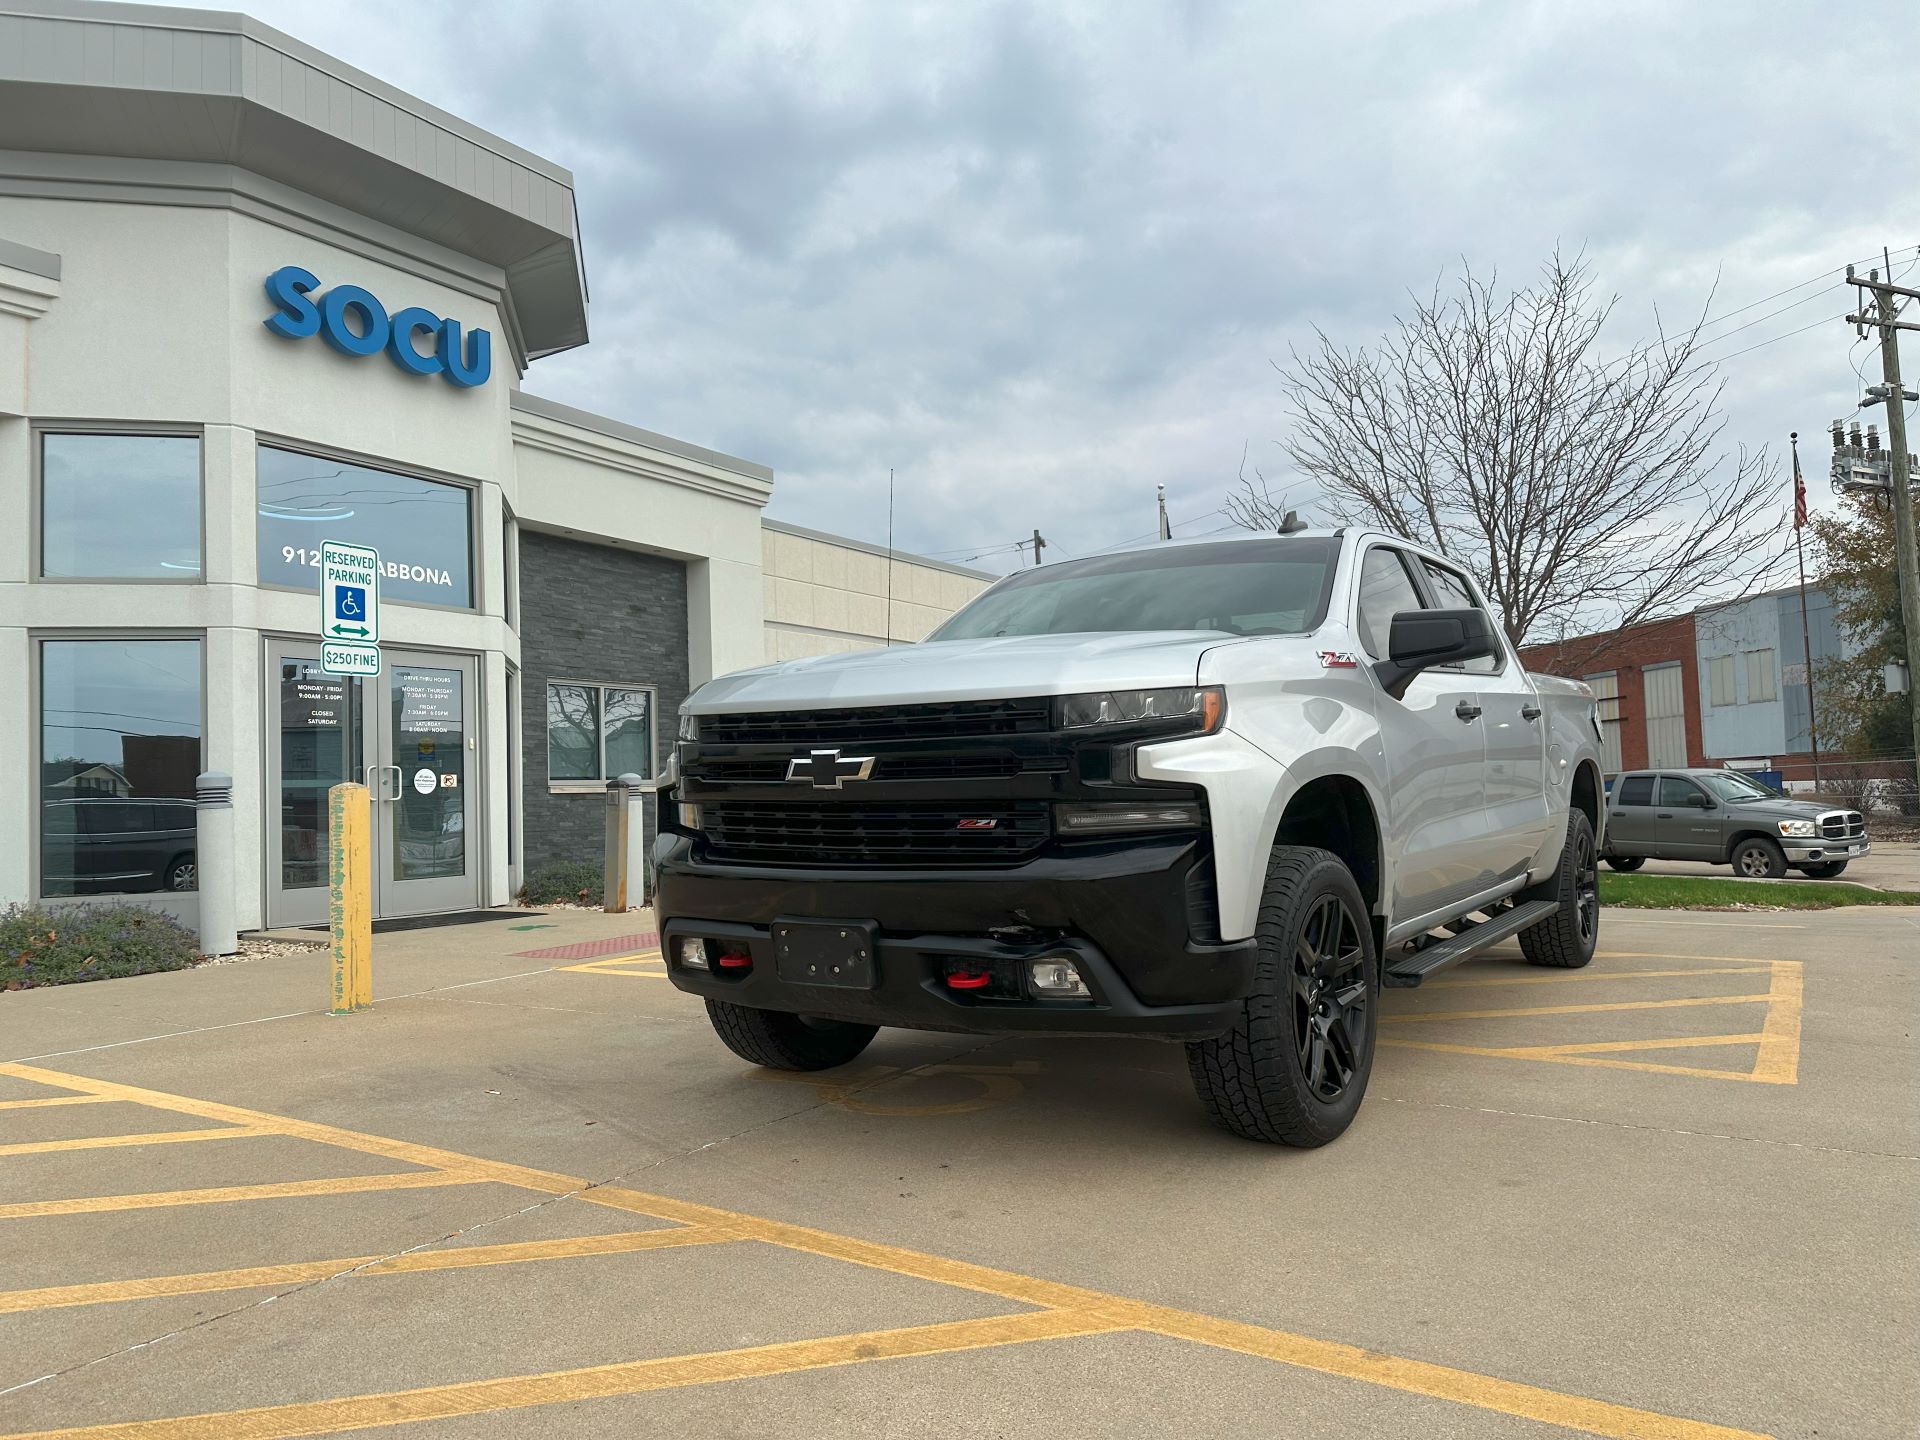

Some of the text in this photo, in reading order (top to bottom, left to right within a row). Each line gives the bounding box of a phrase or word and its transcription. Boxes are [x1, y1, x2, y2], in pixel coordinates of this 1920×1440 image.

[263, 265, 491, 388] SOCU
[325, 550, 374, 569] RESERVED
[328, 567, 372, 585] PARKING
[377, 560, 452, 586] ABBONA
[325, 651, 377, 666] $250 FINE
